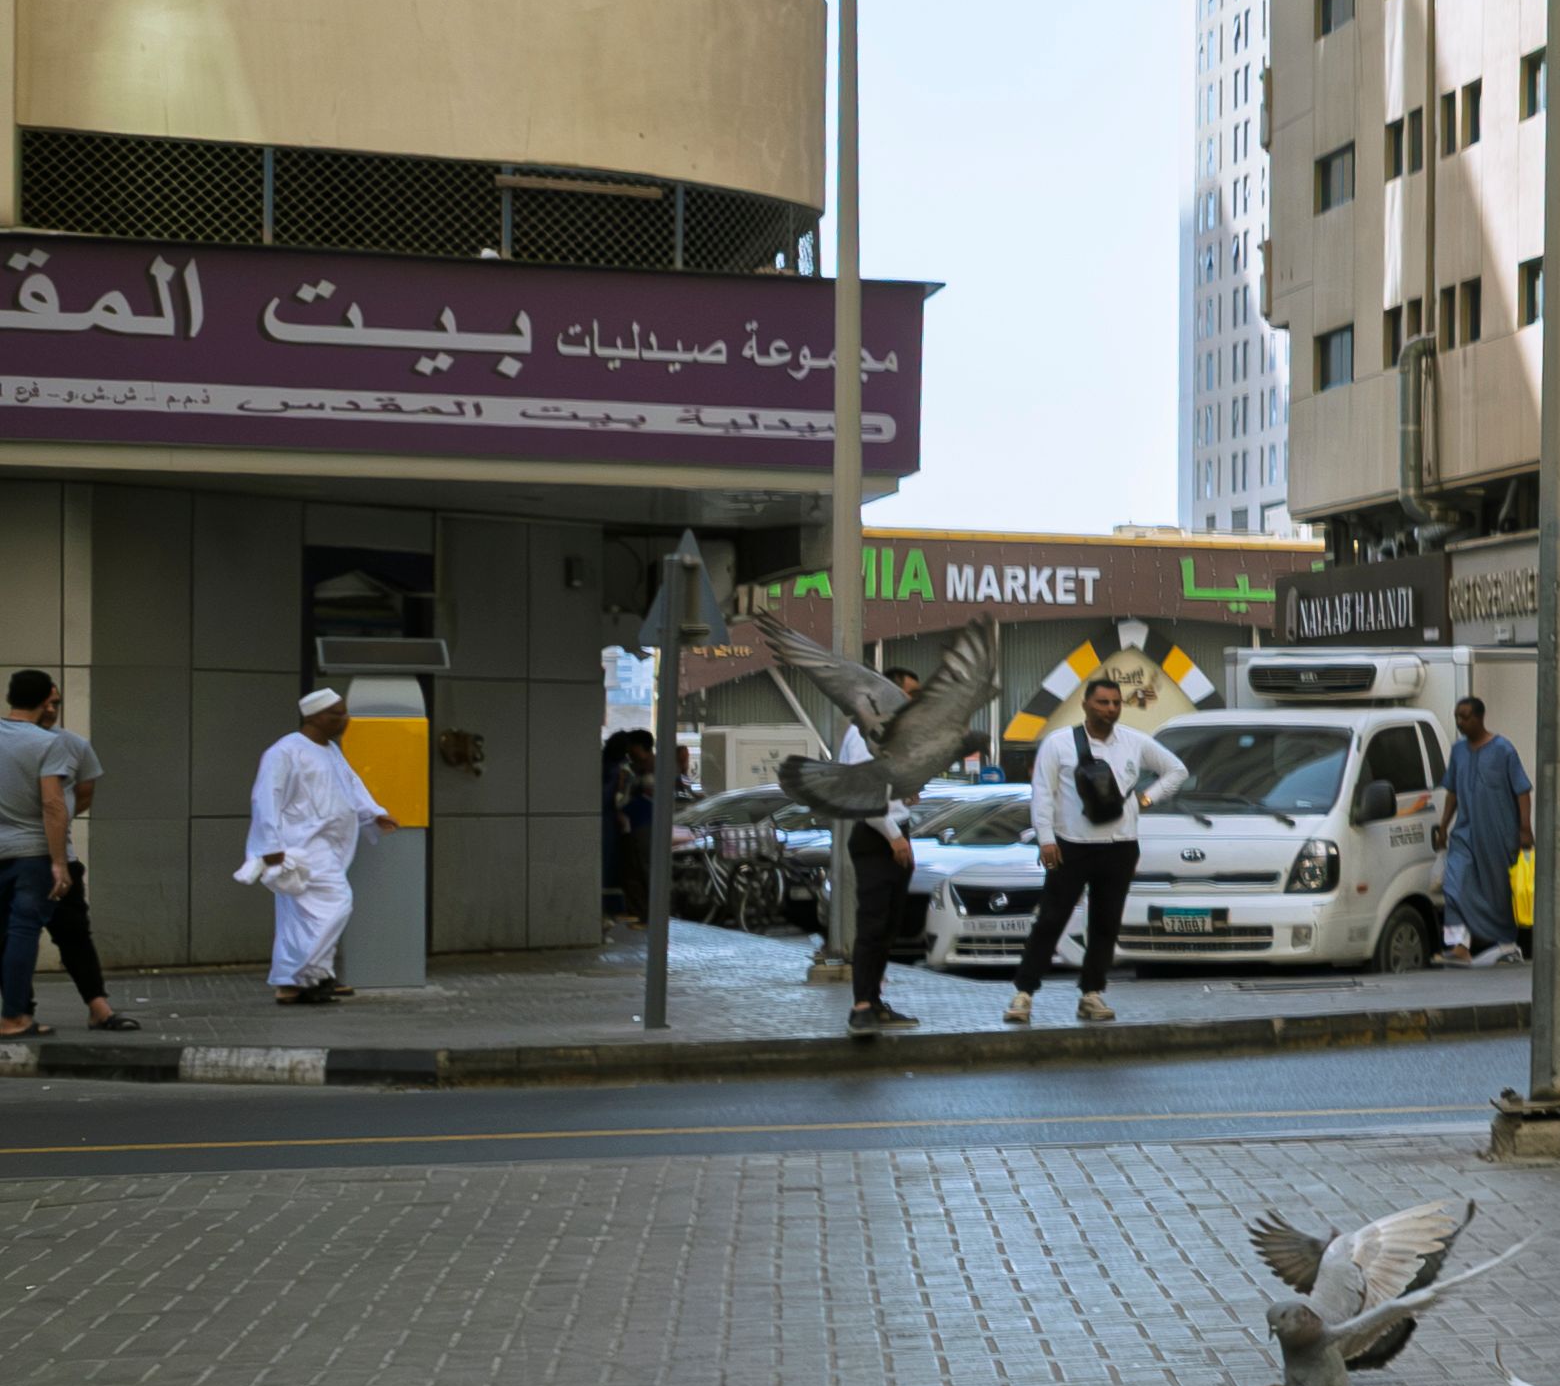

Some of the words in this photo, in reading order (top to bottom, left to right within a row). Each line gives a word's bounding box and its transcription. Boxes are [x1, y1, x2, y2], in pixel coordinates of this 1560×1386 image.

[0, 247, 204, 339] المق
[263, 278, 532, 379] بيت
[556, 319, 728, 374] صيدليات
[236, 396, 484, 419] المقدس
[520, 405, 647, 431] بيت
[767, 547, 935, 601] AIA
[946, 562, 1101, 605] MARKET
[1300, 593, 1352, 639] NAYAAB
[1355, 586, 1416, 633] HAANDI
